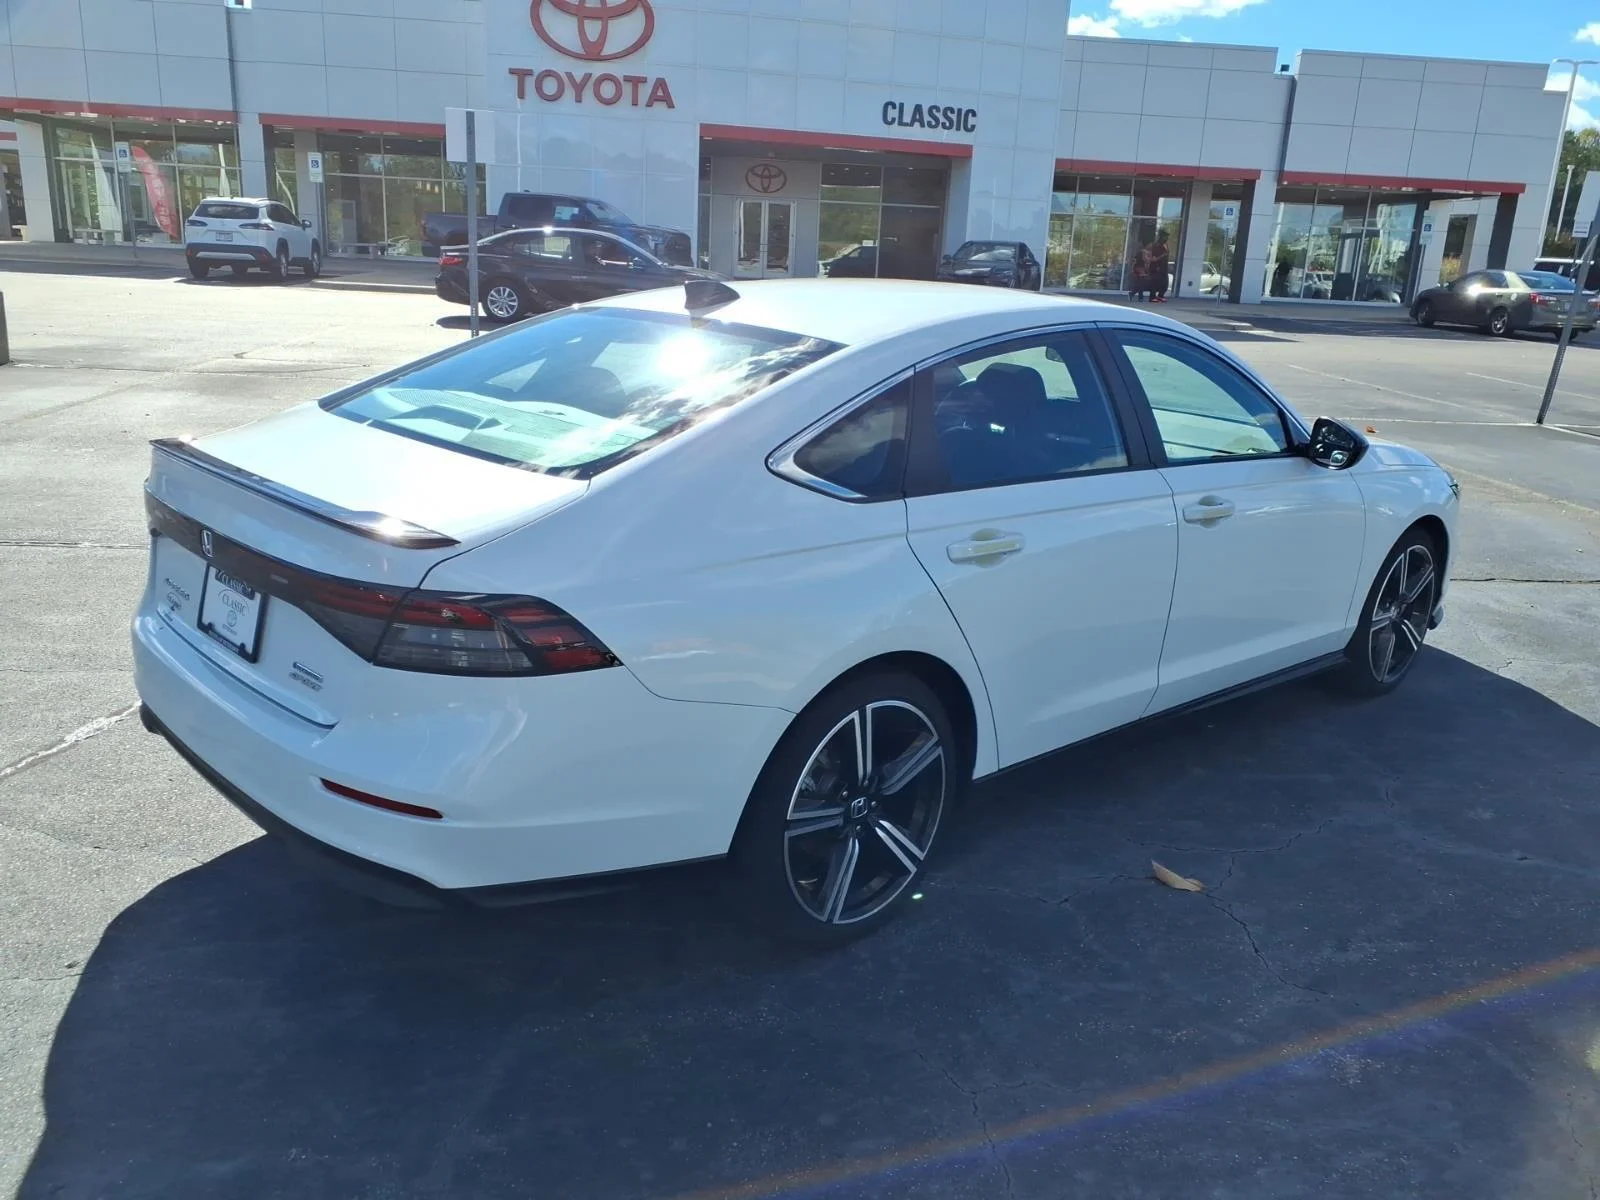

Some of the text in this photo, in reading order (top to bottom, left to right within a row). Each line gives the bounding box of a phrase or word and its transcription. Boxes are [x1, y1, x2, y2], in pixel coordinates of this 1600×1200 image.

[508, 68, 676, 109] TOYOTA
[882, 100, 978, 133] CLASSIC
[221, 593, 247, 616] CLASSIC
